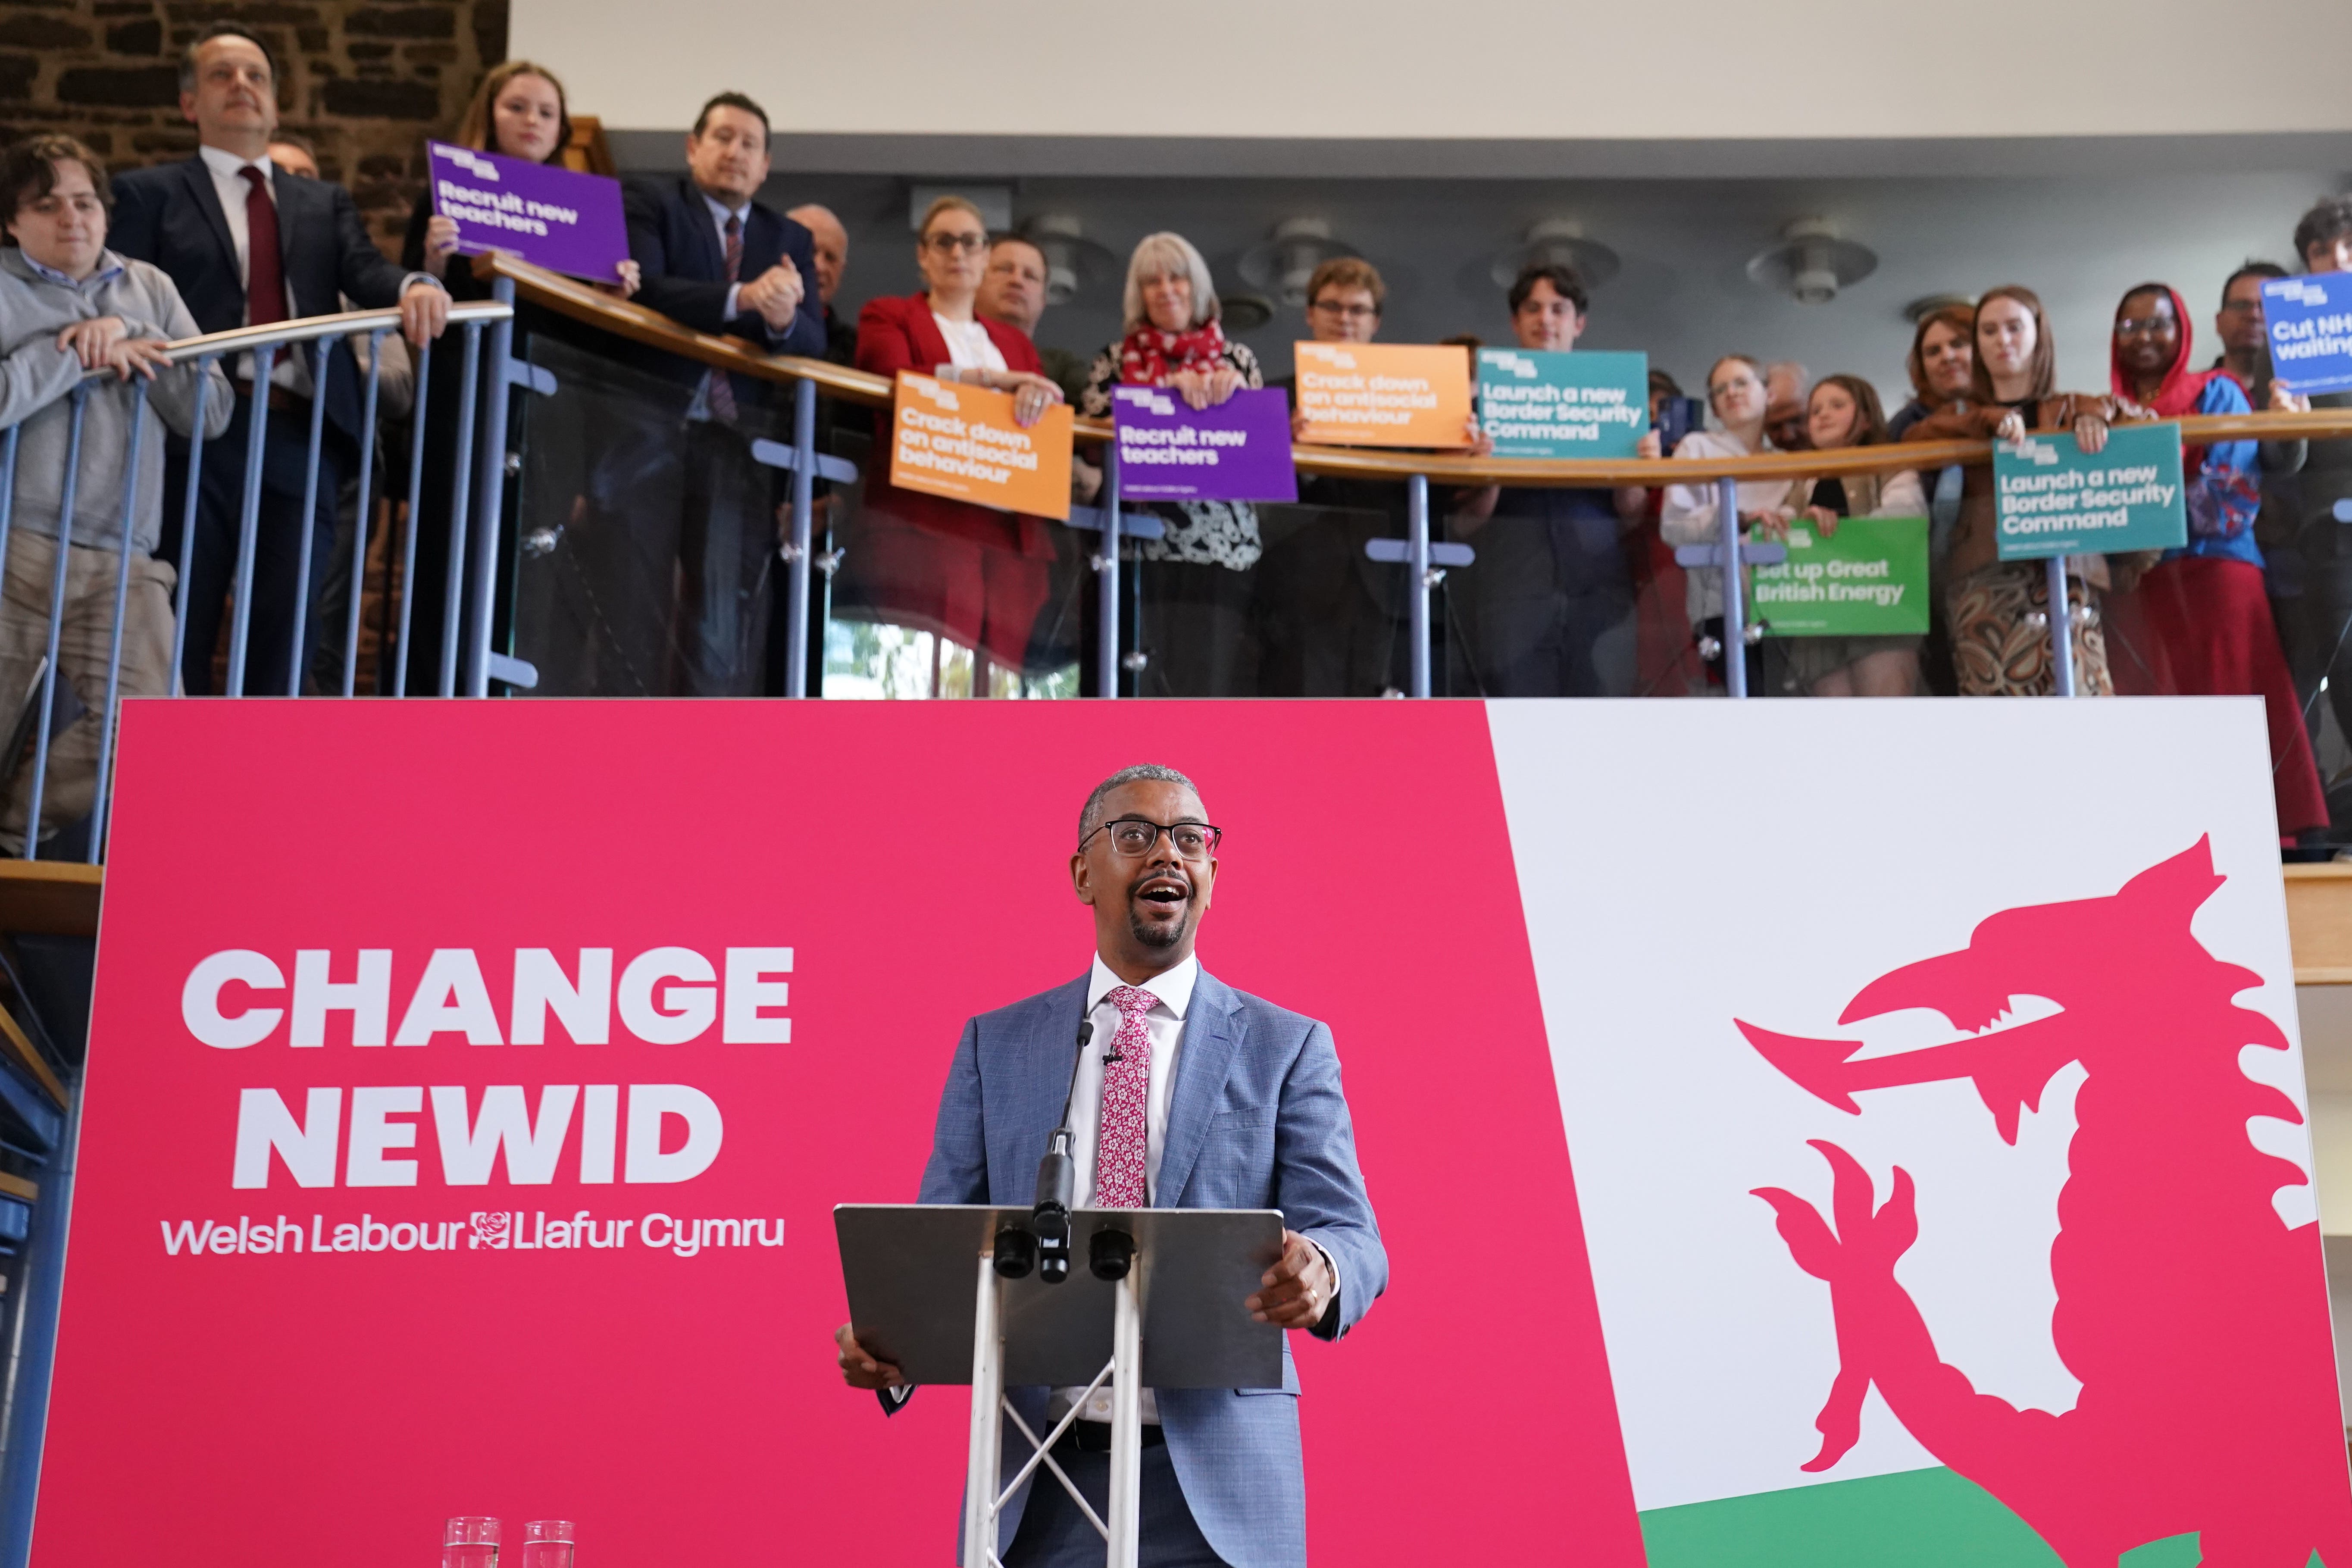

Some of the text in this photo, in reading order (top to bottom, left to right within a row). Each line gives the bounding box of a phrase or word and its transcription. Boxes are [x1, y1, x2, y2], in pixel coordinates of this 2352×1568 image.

[438, 180, 578, 225] Recruit new
[440, 199, 548, 237] teachers
[2273, 317, 2316, 341] Cut
[1302, 372, 1429, 391] Crack down
[1483, 383, 1626, 404] Launch a new
[1303, 391, 1437, 409] on antisocial
[901, 407, 1030, 449] Crack down
[1303, 407, 1411, 425] behaviour
[1484, 402, 1642, 428] Border Security
[1119, 425, 1246, 447] Recruit new
[1484, 421, 1599, 440] Command
[900, 428, 1038, 470] on antisocial
[1121, 445, 1219, 465] teachers
[899, 446, 1011, 484] behaviour
[2001, 466, 2157, 494] Launch a new
[2002, 483, 2175, 515] Border Security
[2002, 507, 2128, 535] Command
[1794, 564, 1822, 583] up
[1827, 559, 1889, 578] Great
[1756, 583, 1905, 606] British Energy
[181, 946, 794, 1050] CHANGE
[232, 1083, 724, 1189] NEWID
[160, 1210, 785, 1258] Welsh Labour Llafur Cymru
